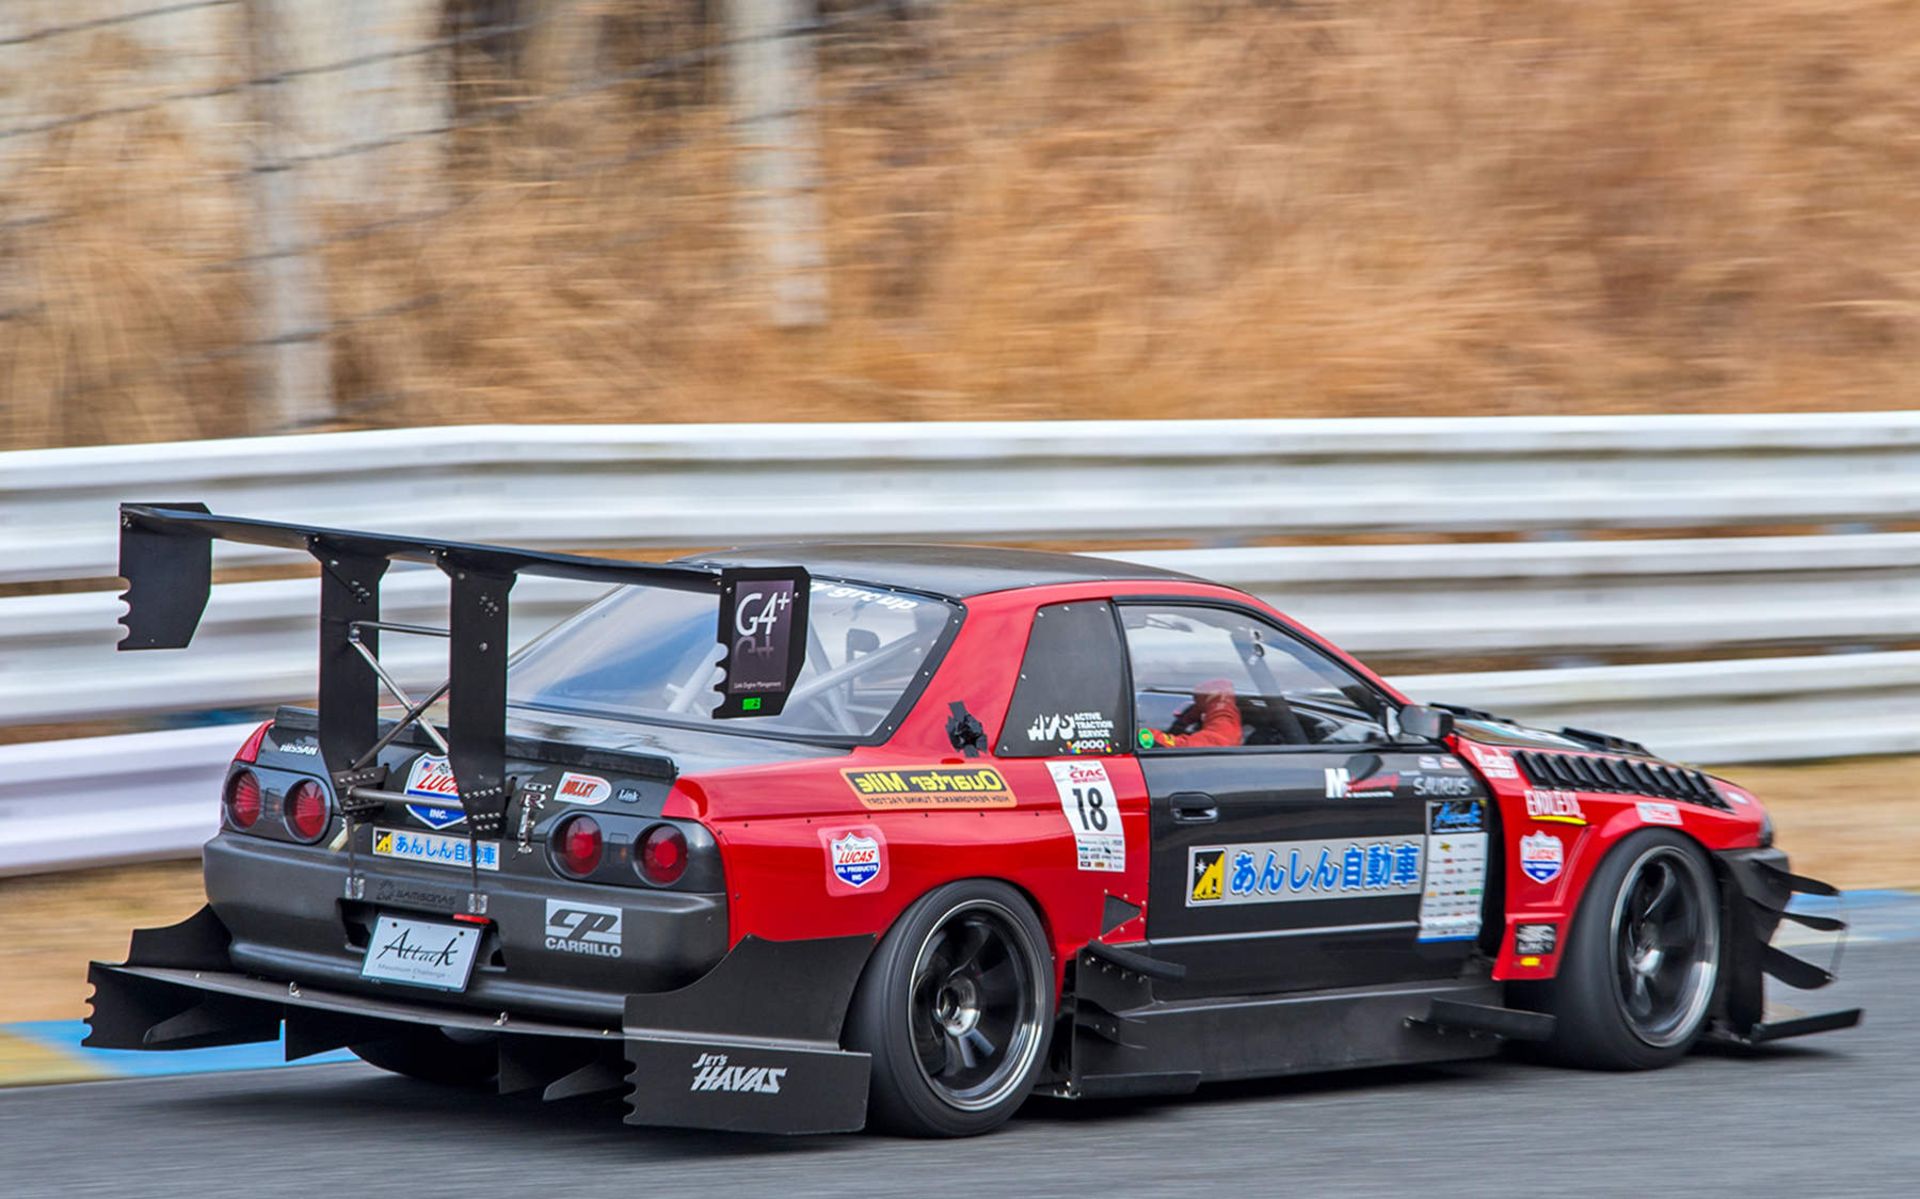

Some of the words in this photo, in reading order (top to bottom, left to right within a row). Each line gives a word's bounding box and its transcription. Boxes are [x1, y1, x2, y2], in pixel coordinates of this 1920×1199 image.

[735, 592, 790, 636] G4+
[1074, 712, 1101, 721] ACTIVE
[1075, 720, 1114, 729] TRACTION
[1078, 729, 1110, 739] SERVICE
[280, 743, 318, 756] NISSAN
[1072, 739, 1105, 750] 4000
[1070, 769, 1104, 779] CTAC
[1413, 776, 1472, 796] SAURUS
[617, 788, 639, 802] Link
[429, 808, 448, 820] INC.
[1072, 787, 1108, 831] 18
[838, 849, 875, 864] LUCAS
[837, 866, 846, 874] OIL
[847, 864, 877, 873] PRODUCTS
[1230, 842, 1421, 895] あんしん自動車
[376, 928, 458, 967] Attack
[545, 936, 622, 958] CARRILLO
[690, 1066, 788, 1094] HAVAS
